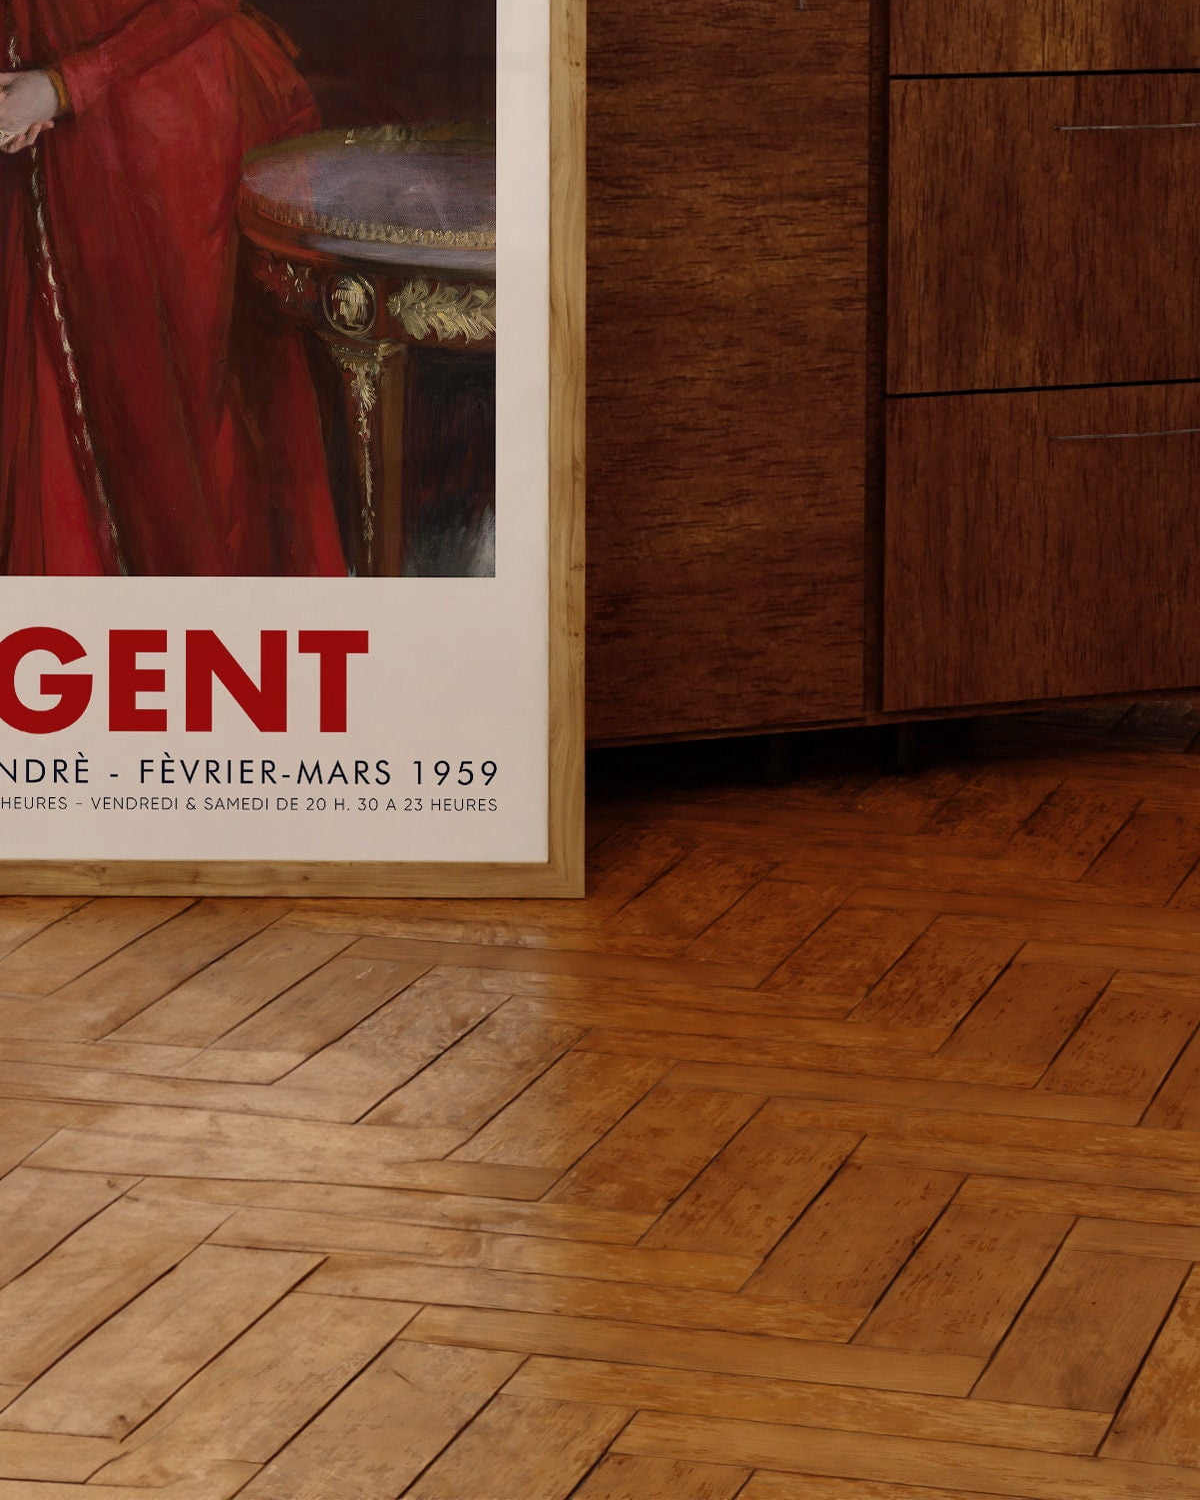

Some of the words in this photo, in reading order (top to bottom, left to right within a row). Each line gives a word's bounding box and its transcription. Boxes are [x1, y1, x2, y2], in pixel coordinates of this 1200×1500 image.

[140, 752, 391, 785] FÈVRIER-MARS
[413, 760, 498, 786] 1959
[2, 796, 68, 810] HEURES
[91, 797, 178, 810] VENDREDI
[186, 797, 200, 810] &
[204, 797, 269, 811] SAMEDI
[277, 798, 299, 811] DE
[306, 797, 327, 811] 20
[335, 798, 351, 811] H.
[358, 797, 379, 812] 30
[386, 798, 397, 811] A
[404, 798, 424, 811] 23
[431, 798, 498, 812] HEURES
